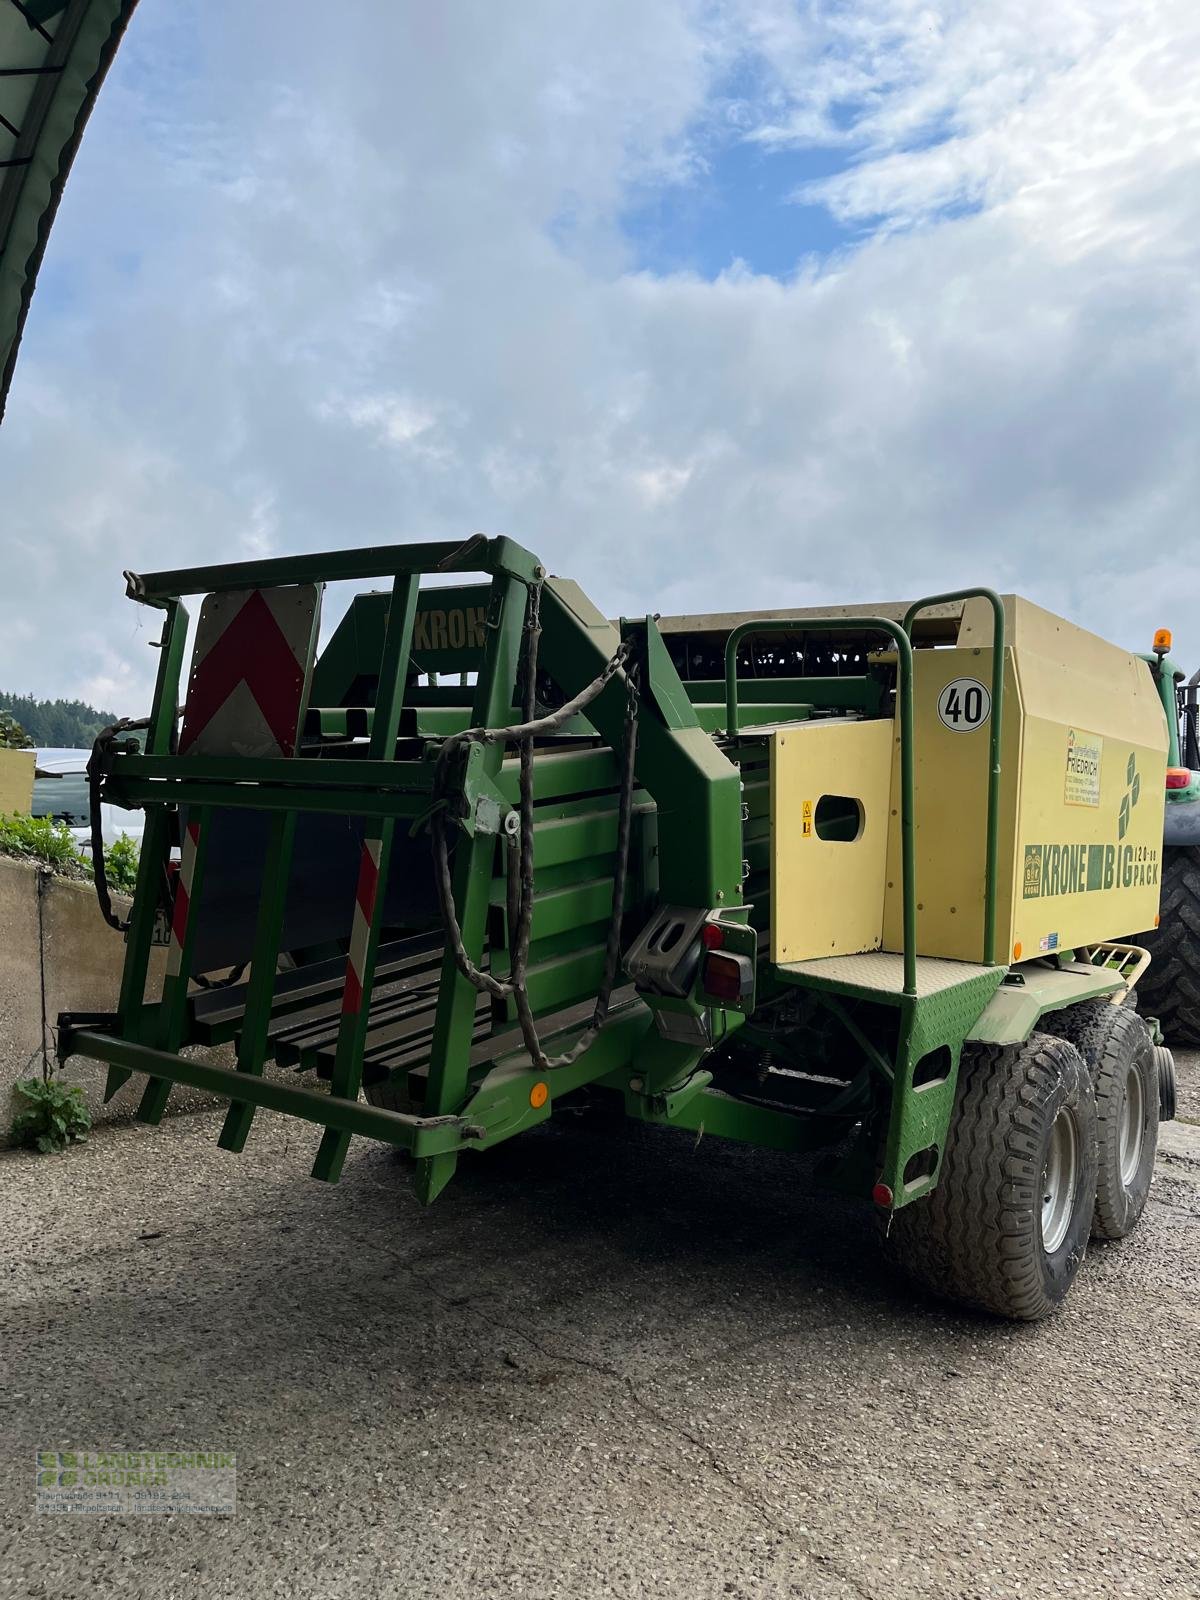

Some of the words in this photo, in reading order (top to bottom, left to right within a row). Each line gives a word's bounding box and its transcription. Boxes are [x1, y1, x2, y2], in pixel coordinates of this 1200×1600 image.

[413, 606, 487, 650] KRON
[945, 687, 982, 723] 40
[1066, 748, 1097, 776] FRIEDRICH
[1041, 844, 1087, 897] KRONE
[1104, 844, 1133, 889] BIG
[1133, 863, 1158, 887] PACK
